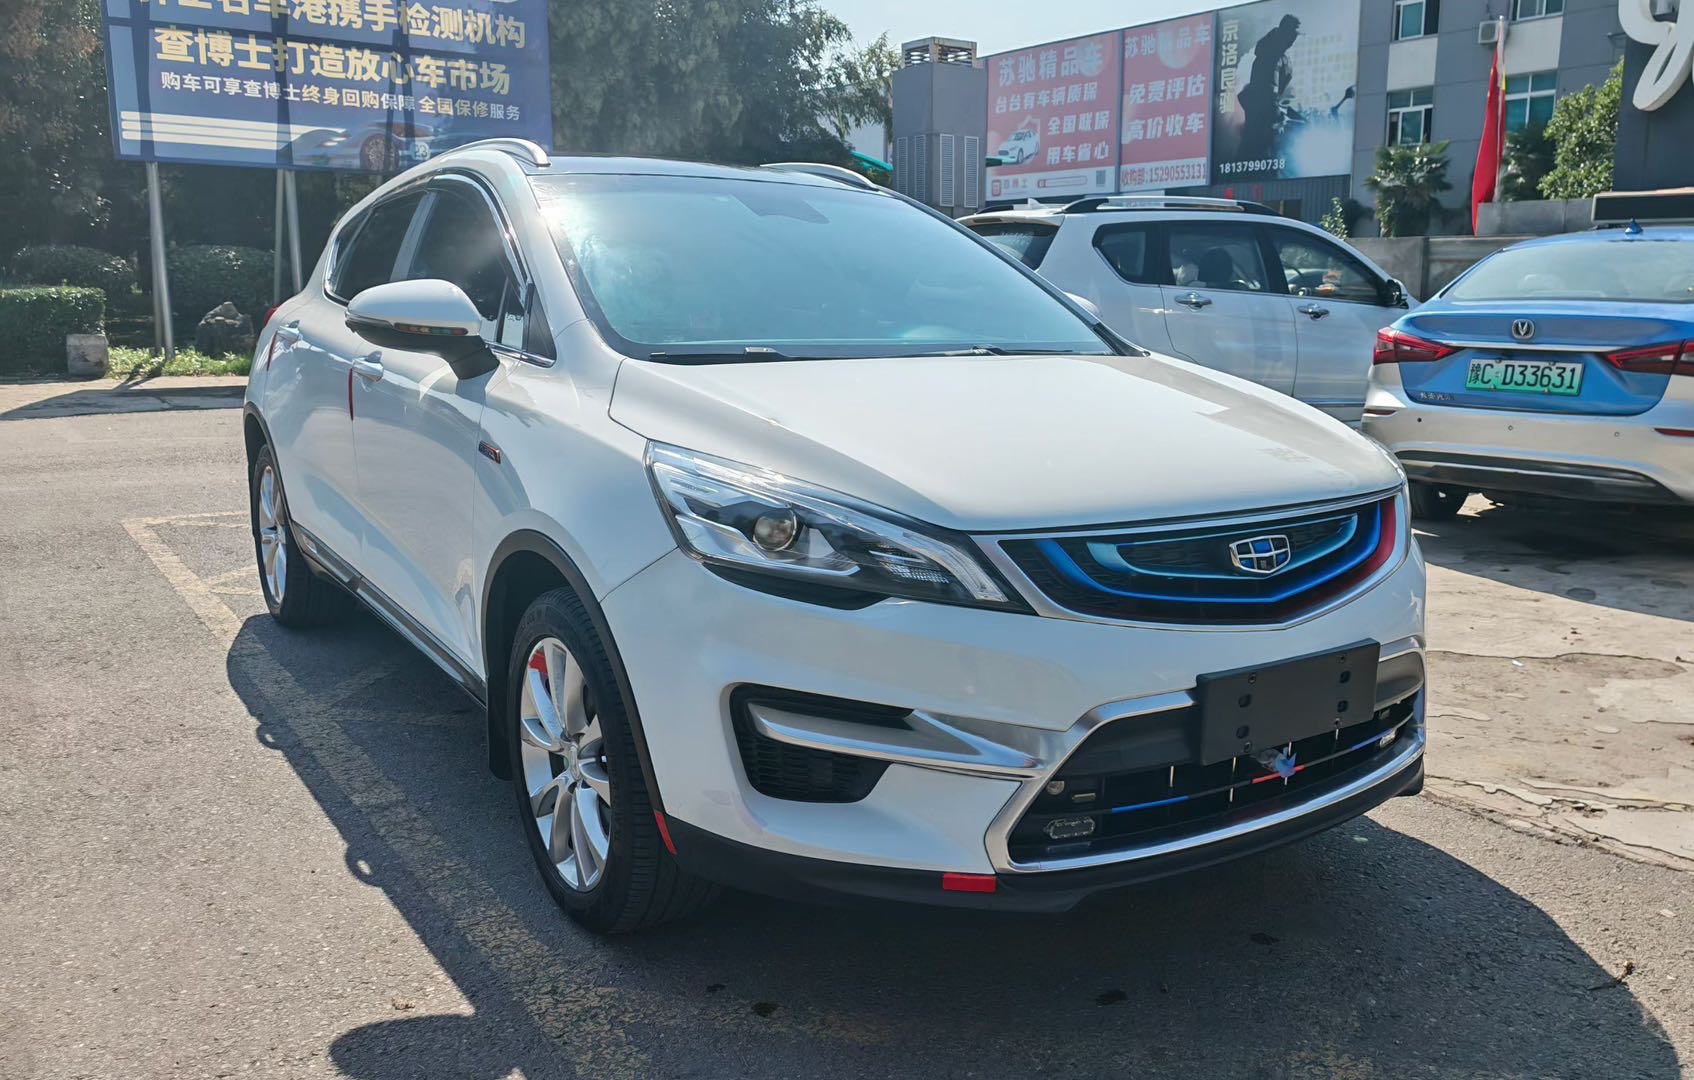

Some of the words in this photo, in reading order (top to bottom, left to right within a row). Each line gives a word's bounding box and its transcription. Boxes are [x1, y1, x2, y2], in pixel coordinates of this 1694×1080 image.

[140, 0, 526, 49] 车港携手检测机构
[1124, 23, 1211, 58] 苏驰品车
[154, 24, 511, 96] 查博士打造放心车市场
[161, 71, 416, 112] 购车可享查博士终身回购保障
[418, 95, 521, 121] 全国保修服务
[1129, 73, 1206, 104] 免费评估
[1047, 110, 1110, 136] 全国联保
[1128, 112, 1205, 140] 高价收车
[1046, 141, 1109, 165] 用车省心
[1219, 158, 1286, 174] 18137990738
